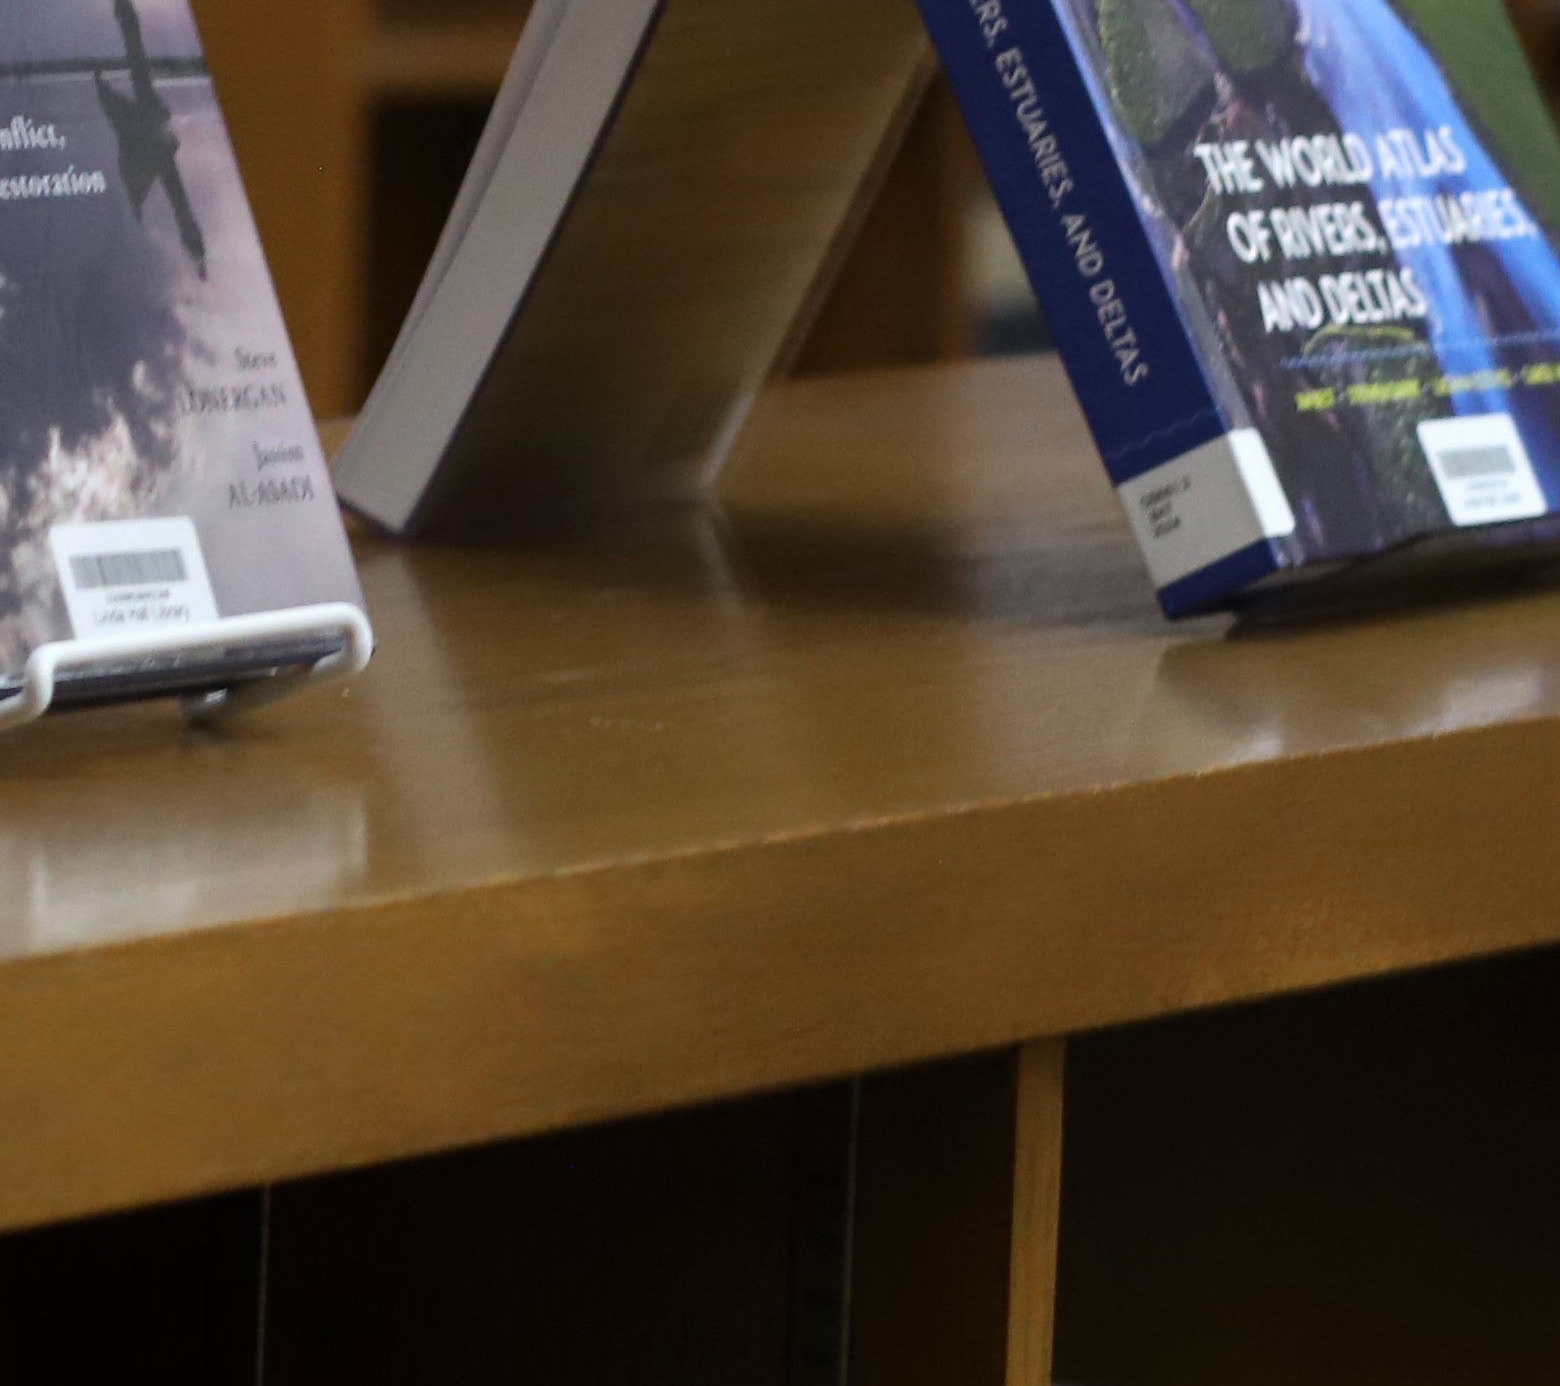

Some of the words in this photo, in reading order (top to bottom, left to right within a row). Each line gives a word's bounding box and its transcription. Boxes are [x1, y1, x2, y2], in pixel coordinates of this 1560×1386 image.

[1195, 143, 1264, 194] THE
[1257, 135, 1372, 188] WORLD
[1377, 127, 1466, 176] ATLAS
[995, 52, 1075, 210] ESTUARIES,
[1062, 213, 1101, 282] AND
[1088, 283, 1148, 389] DELTAS
[1227, 214, 1273, 263] OF
[1276, 205, 1385, 257] RIVERS,
[1381, 192, 1537, 247] ESTUARIES,
[1257, 280, 1320, 332] AND
[1320, 268, 1426, 327] DELTAS
